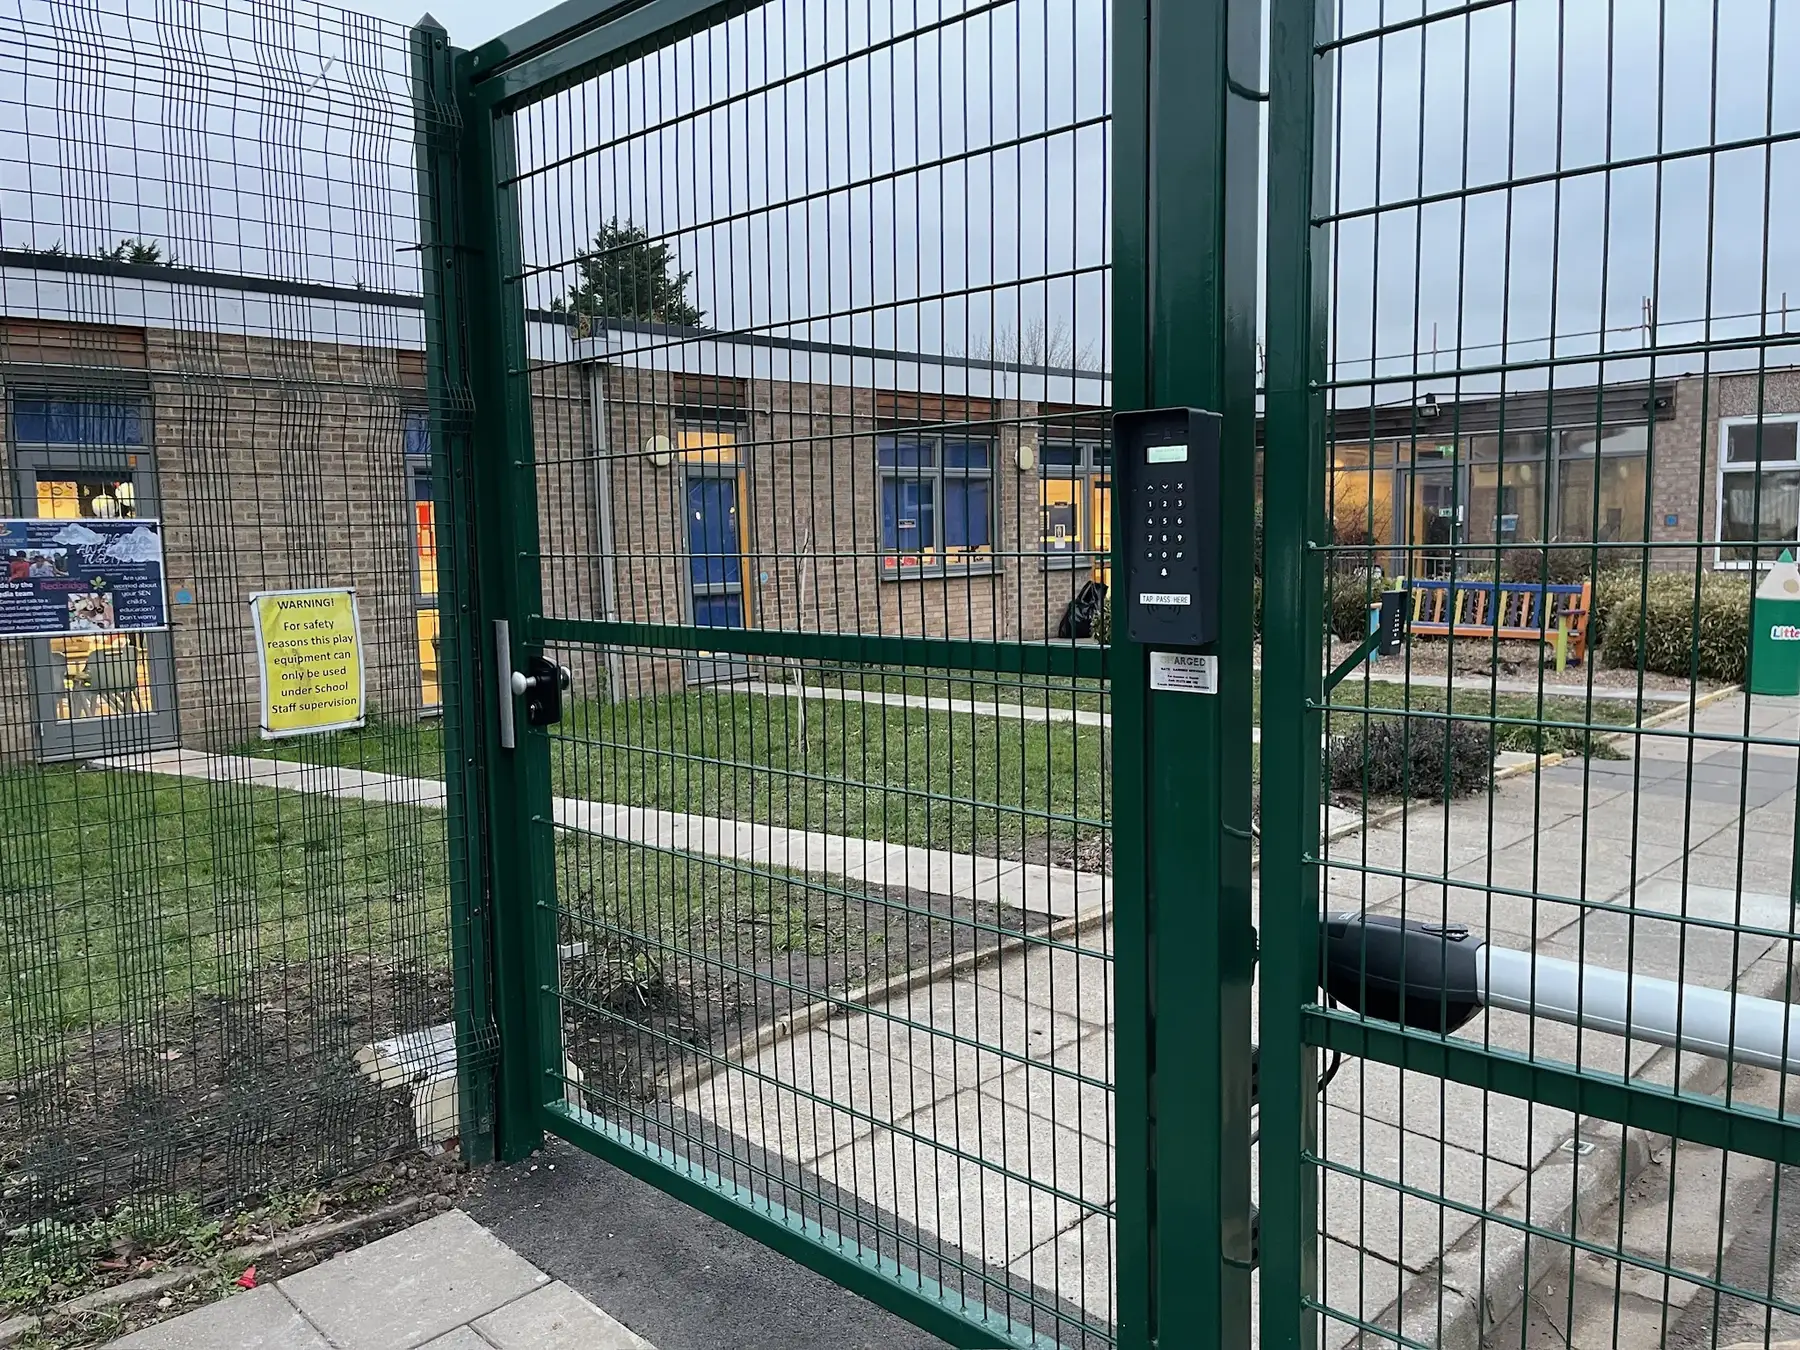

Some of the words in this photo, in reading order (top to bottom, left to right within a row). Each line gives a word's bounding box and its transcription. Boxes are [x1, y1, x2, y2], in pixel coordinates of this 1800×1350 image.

[40, 582, 88, 590] Redbridge
[278, 598, 334, 610] WARNING!
[284, 621, 300, 631] For
[304, 619, 334, 630] safety
[1773, 628, 1800, 638] Litte
[267, 638, 309, 649] reasons
[311, 636, 330, 645] this
[333, 634, 354, 645] play
[274, 652, 331, 666] equipment
[334, 650, 351, 660] can
[281, 671, 304, 681] only
[307, 669, 320, 678] be
[323, 666, 347, 677] used
[281, 686, 313, 697] under
[315, 682, 348, 693] School
[272, 702, 296, 714] Staff
[299, 698, 357, 711] supervision
